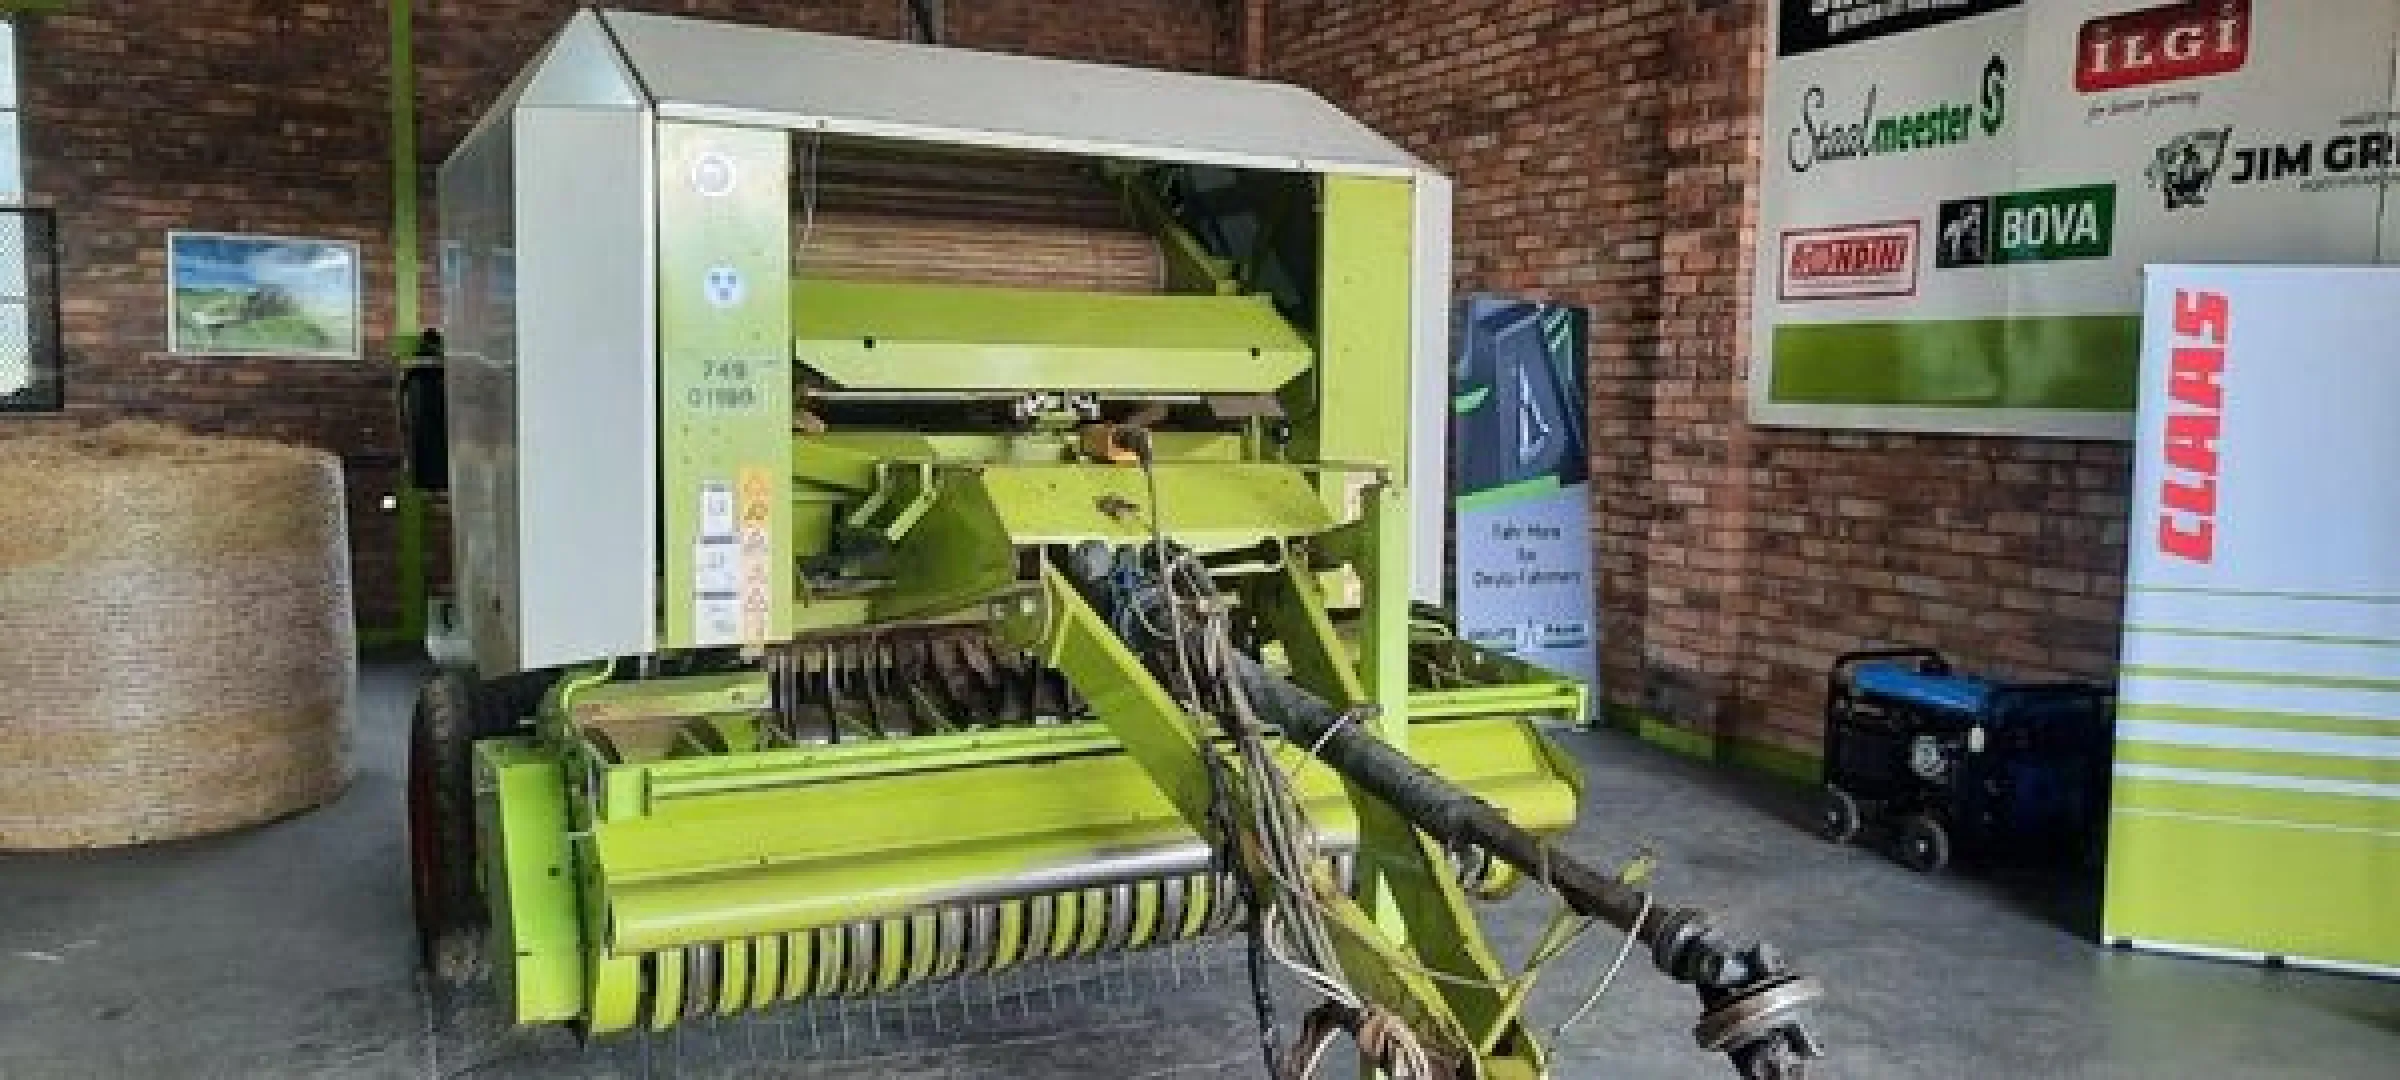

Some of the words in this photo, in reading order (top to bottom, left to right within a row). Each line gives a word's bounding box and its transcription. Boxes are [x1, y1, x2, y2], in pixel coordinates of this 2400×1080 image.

[2231, 140, 2313, 184] JIM
[1999, 199, 2101, 249] BOVA
[2160, 288, 2229, 564] CLAAS
